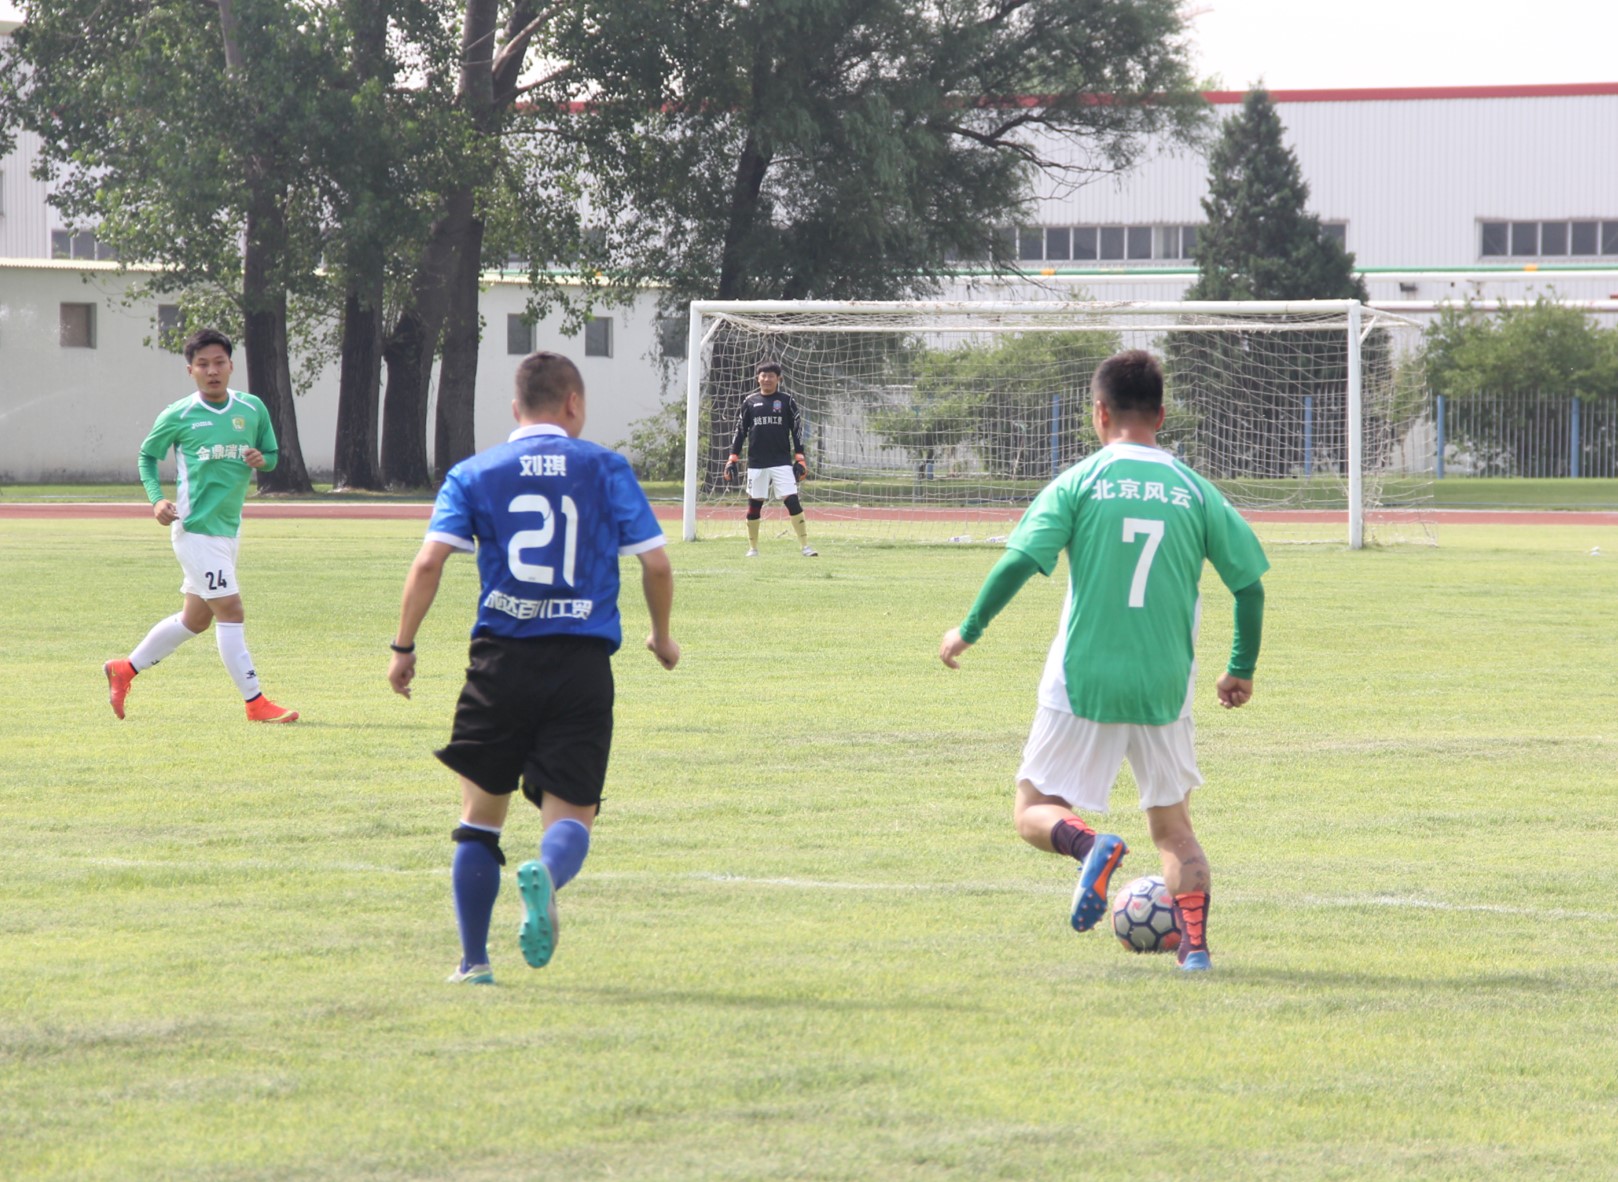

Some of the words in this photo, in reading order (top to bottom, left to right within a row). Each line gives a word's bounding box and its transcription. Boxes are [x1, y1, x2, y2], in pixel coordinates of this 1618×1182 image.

[519, 454, 567, 477] 刘琪
[1091, 478, 1192, 509] 北京风云
[508, 494, 578, 588] 21
[1122, 517, 1165, 608] 7
[205, 569, 227, 591] 24
